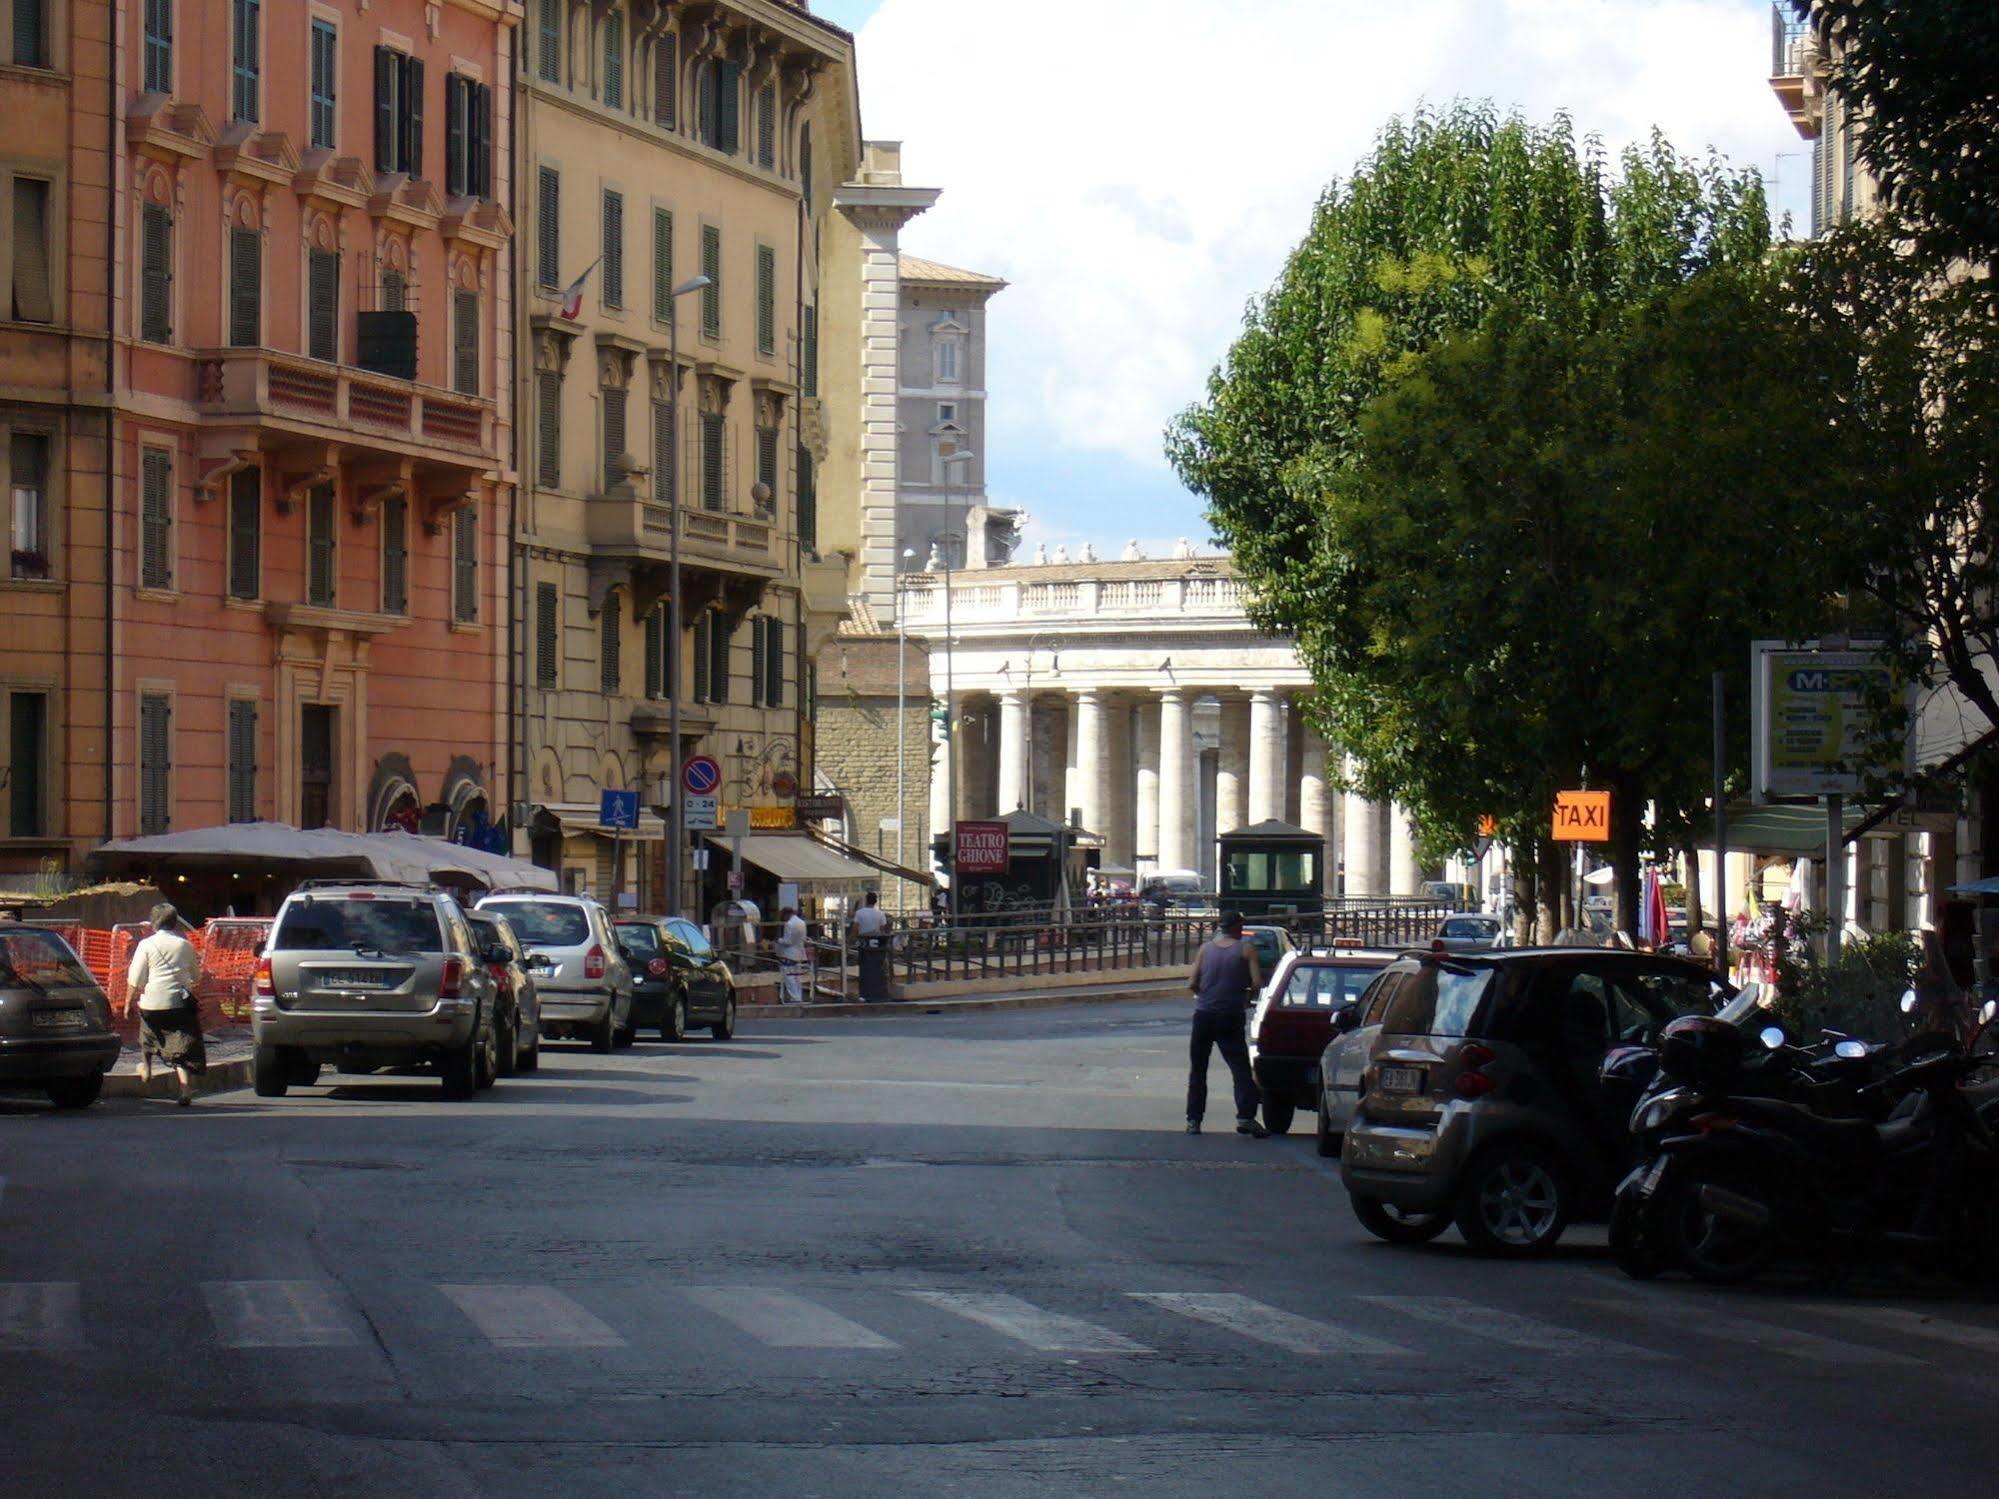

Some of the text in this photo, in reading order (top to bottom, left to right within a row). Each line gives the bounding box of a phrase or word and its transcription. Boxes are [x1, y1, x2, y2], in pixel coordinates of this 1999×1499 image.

[702, 800, 715, 808] 24
[1558, 805, 1605, 827] TAXI
[959, 832, 1005, 848] TEATRO
[958, 848, 1004, 864] GHIONE
